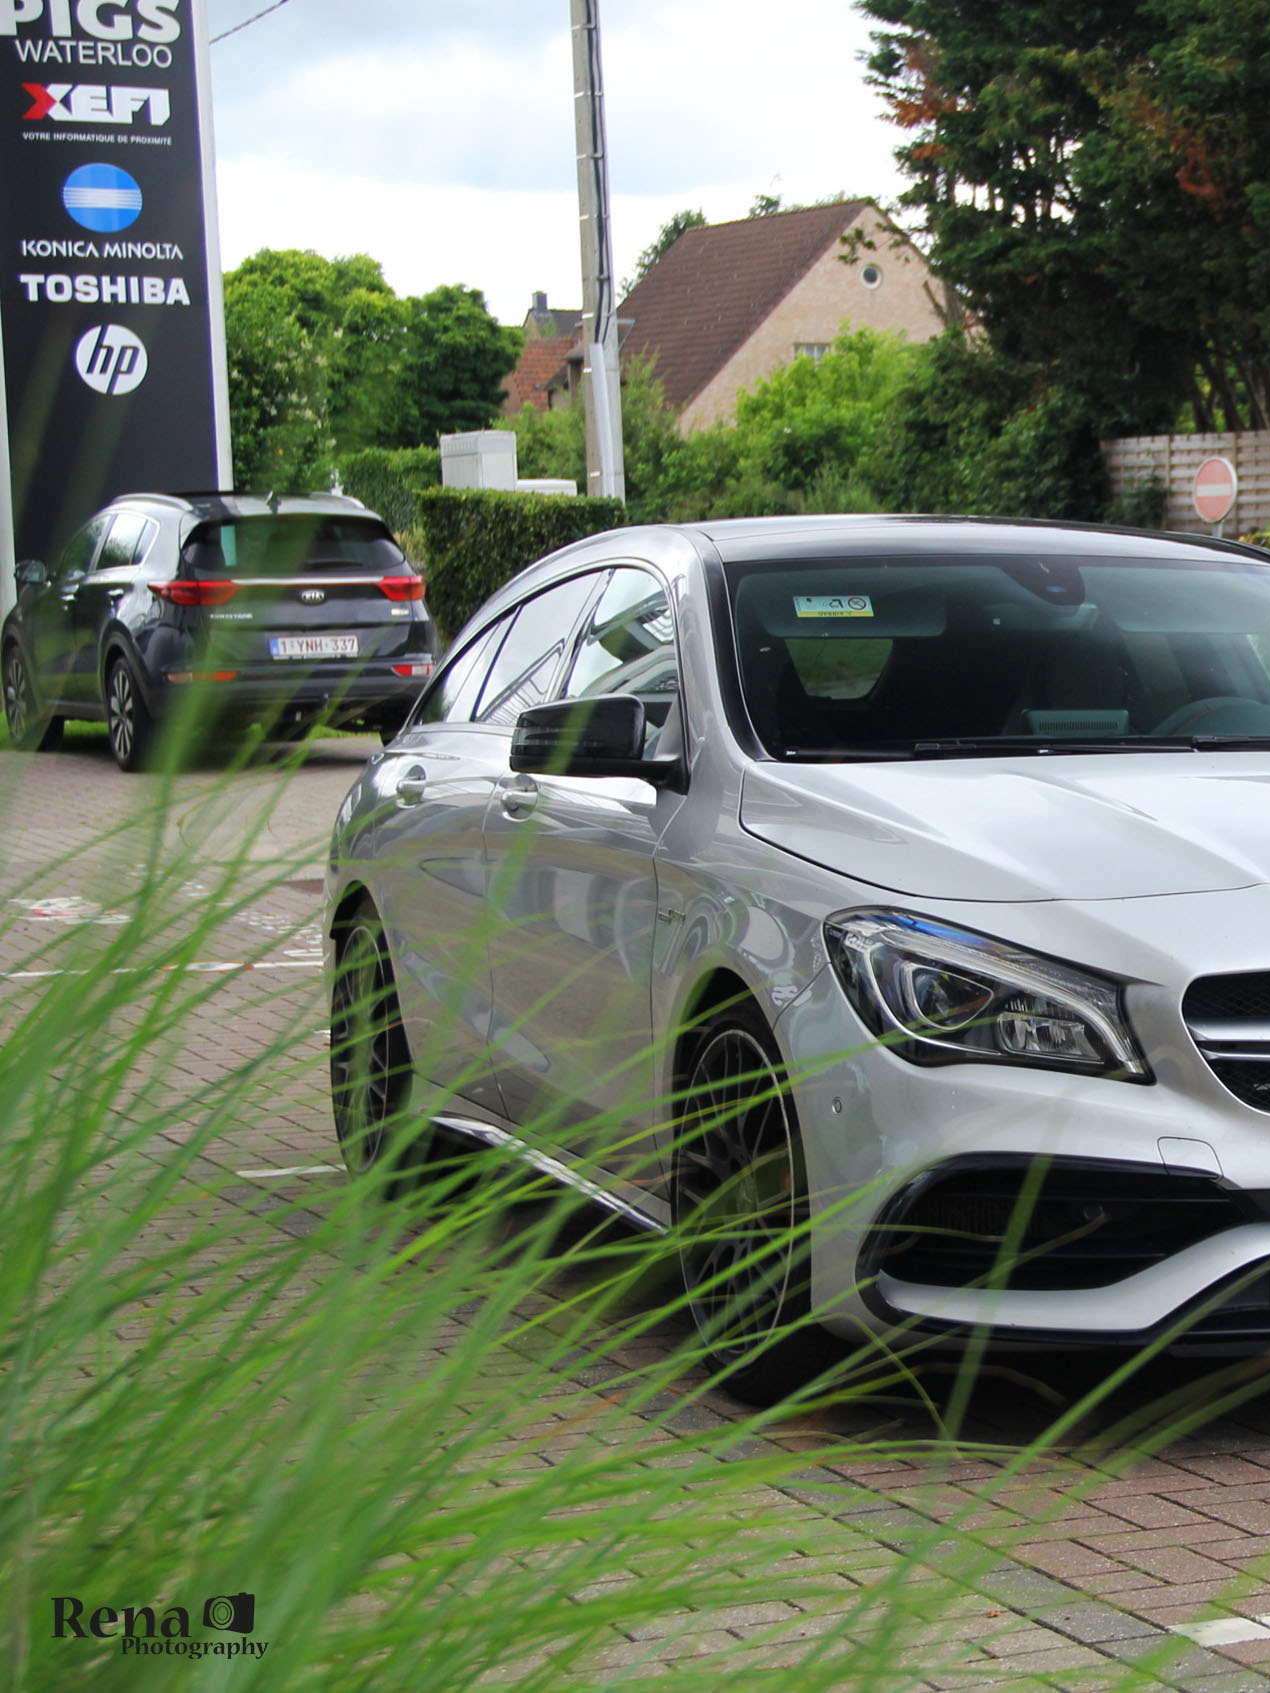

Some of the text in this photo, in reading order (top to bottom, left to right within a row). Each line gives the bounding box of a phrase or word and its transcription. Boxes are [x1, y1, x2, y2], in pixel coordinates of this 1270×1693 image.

[0, 0, 181, 43] PIGS
[15, 39, 173, 68] WATERLOO
[21, 83, 171, 126] XEFI
[22, 132, 172, 146] VOTRE INFORMATIQUE DE PROXIMITÉ
[22, 240, 184, 260] KONICA MINOLTA
[20, 274, 191, 305] TOSHIBA
[83, 324, 142, 394] hp
